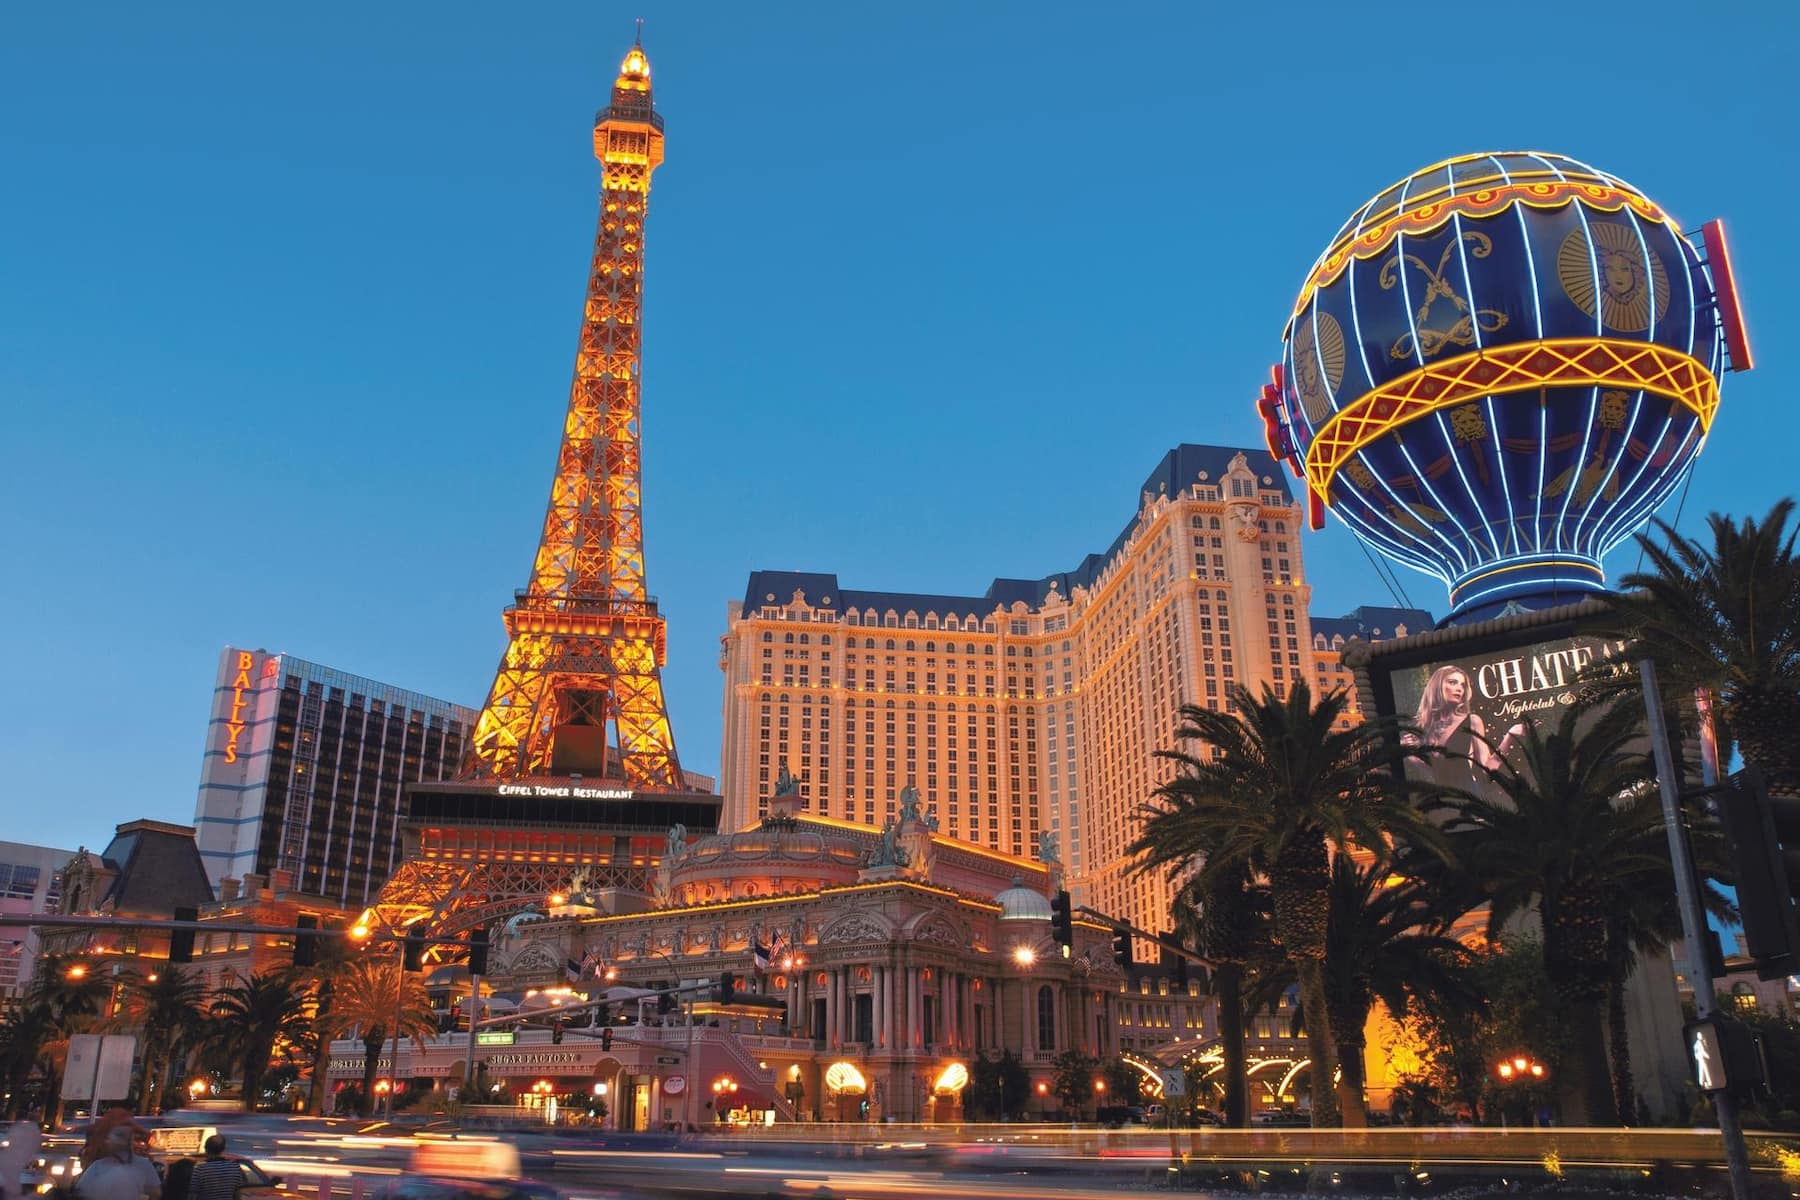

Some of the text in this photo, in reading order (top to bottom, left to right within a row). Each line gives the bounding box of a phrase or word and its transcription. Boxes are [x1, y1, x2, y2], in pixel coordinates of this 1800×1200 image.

[1494, 696, 1555, 719] Nightclub
[498, 785, 633, 799] EIFFEL TOWER RESTAURANT
[490, 1053, 576, 1065] SUGAR FACTORY
